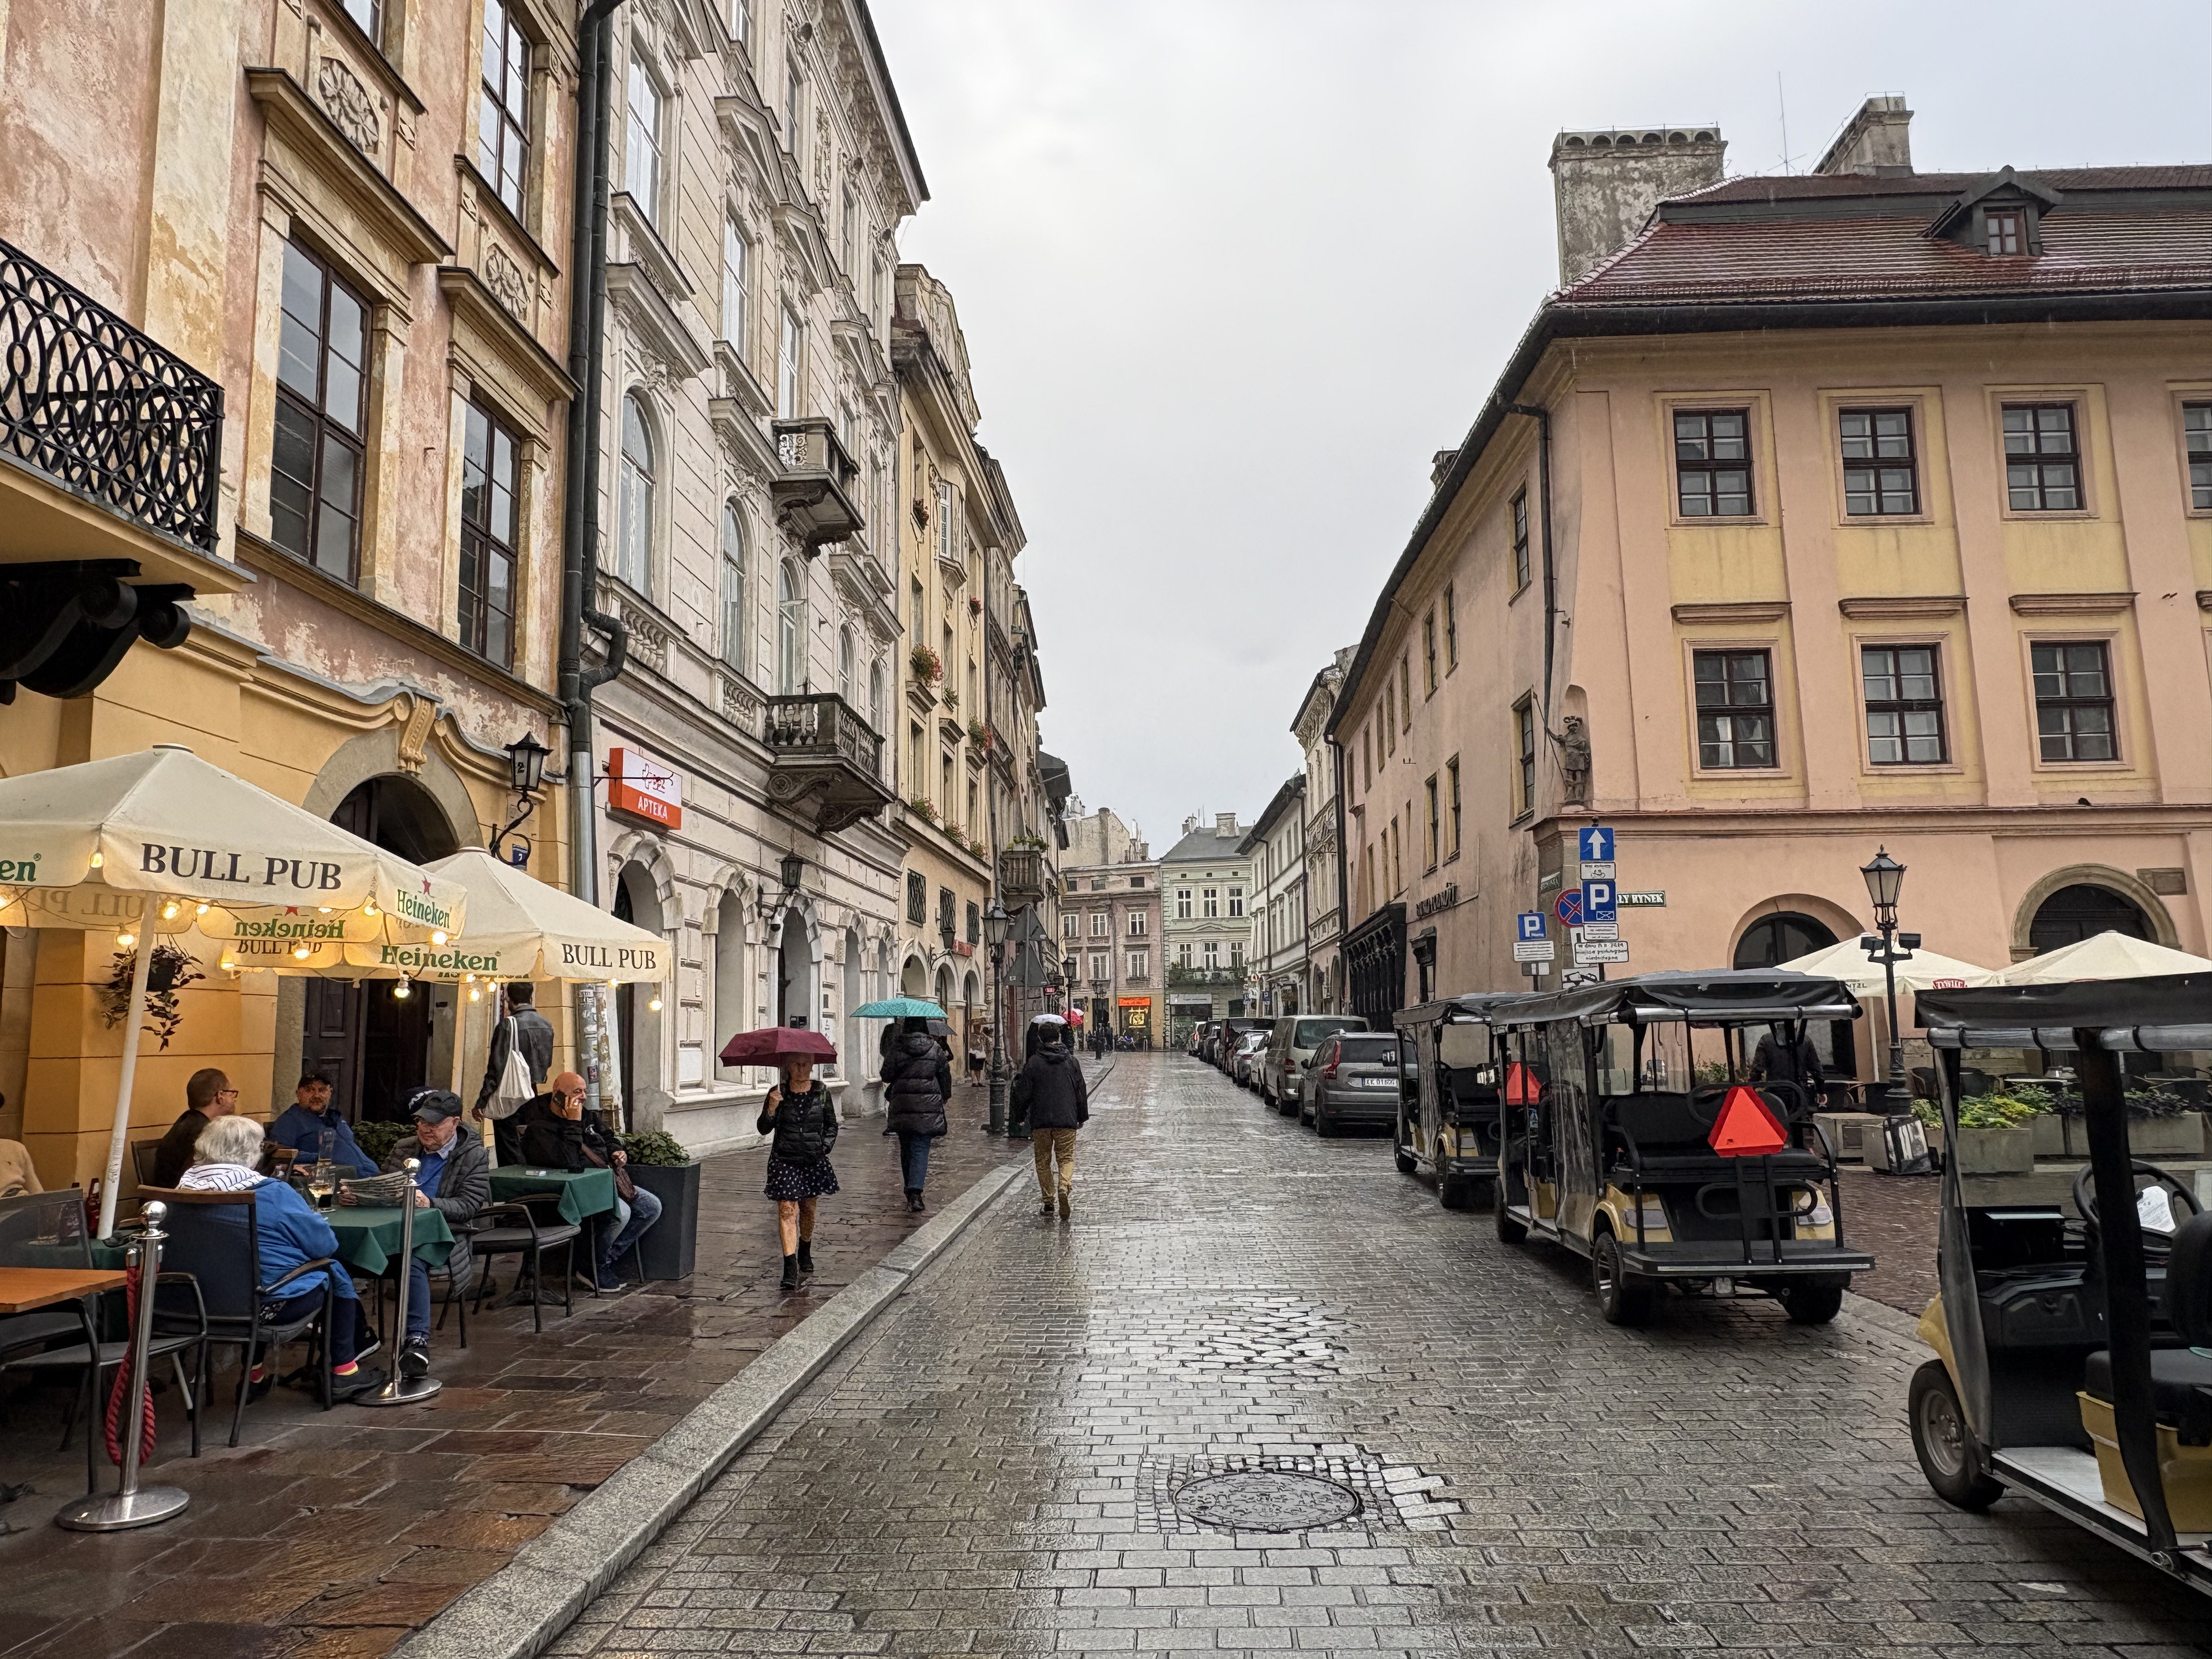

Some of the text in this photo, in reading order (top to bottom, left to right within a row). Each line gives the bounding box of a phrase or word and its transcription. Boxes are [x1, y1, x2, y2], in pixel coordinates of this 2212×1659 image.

[517, 762, 525, 774] 2
[638, 796, 668, 821] APTEKA
[139, 843, 342, 890] BULL PUB
[397, 889, 450, 929] Heineken
[1589, 884, 1610, 910] P
[1631, 894, 1663, 904] RYNEK
[1524, 916, 1540, 937] P
[379, 945, 498, 971] Heineken
[561, 943, 657, 969] BULL PUB
